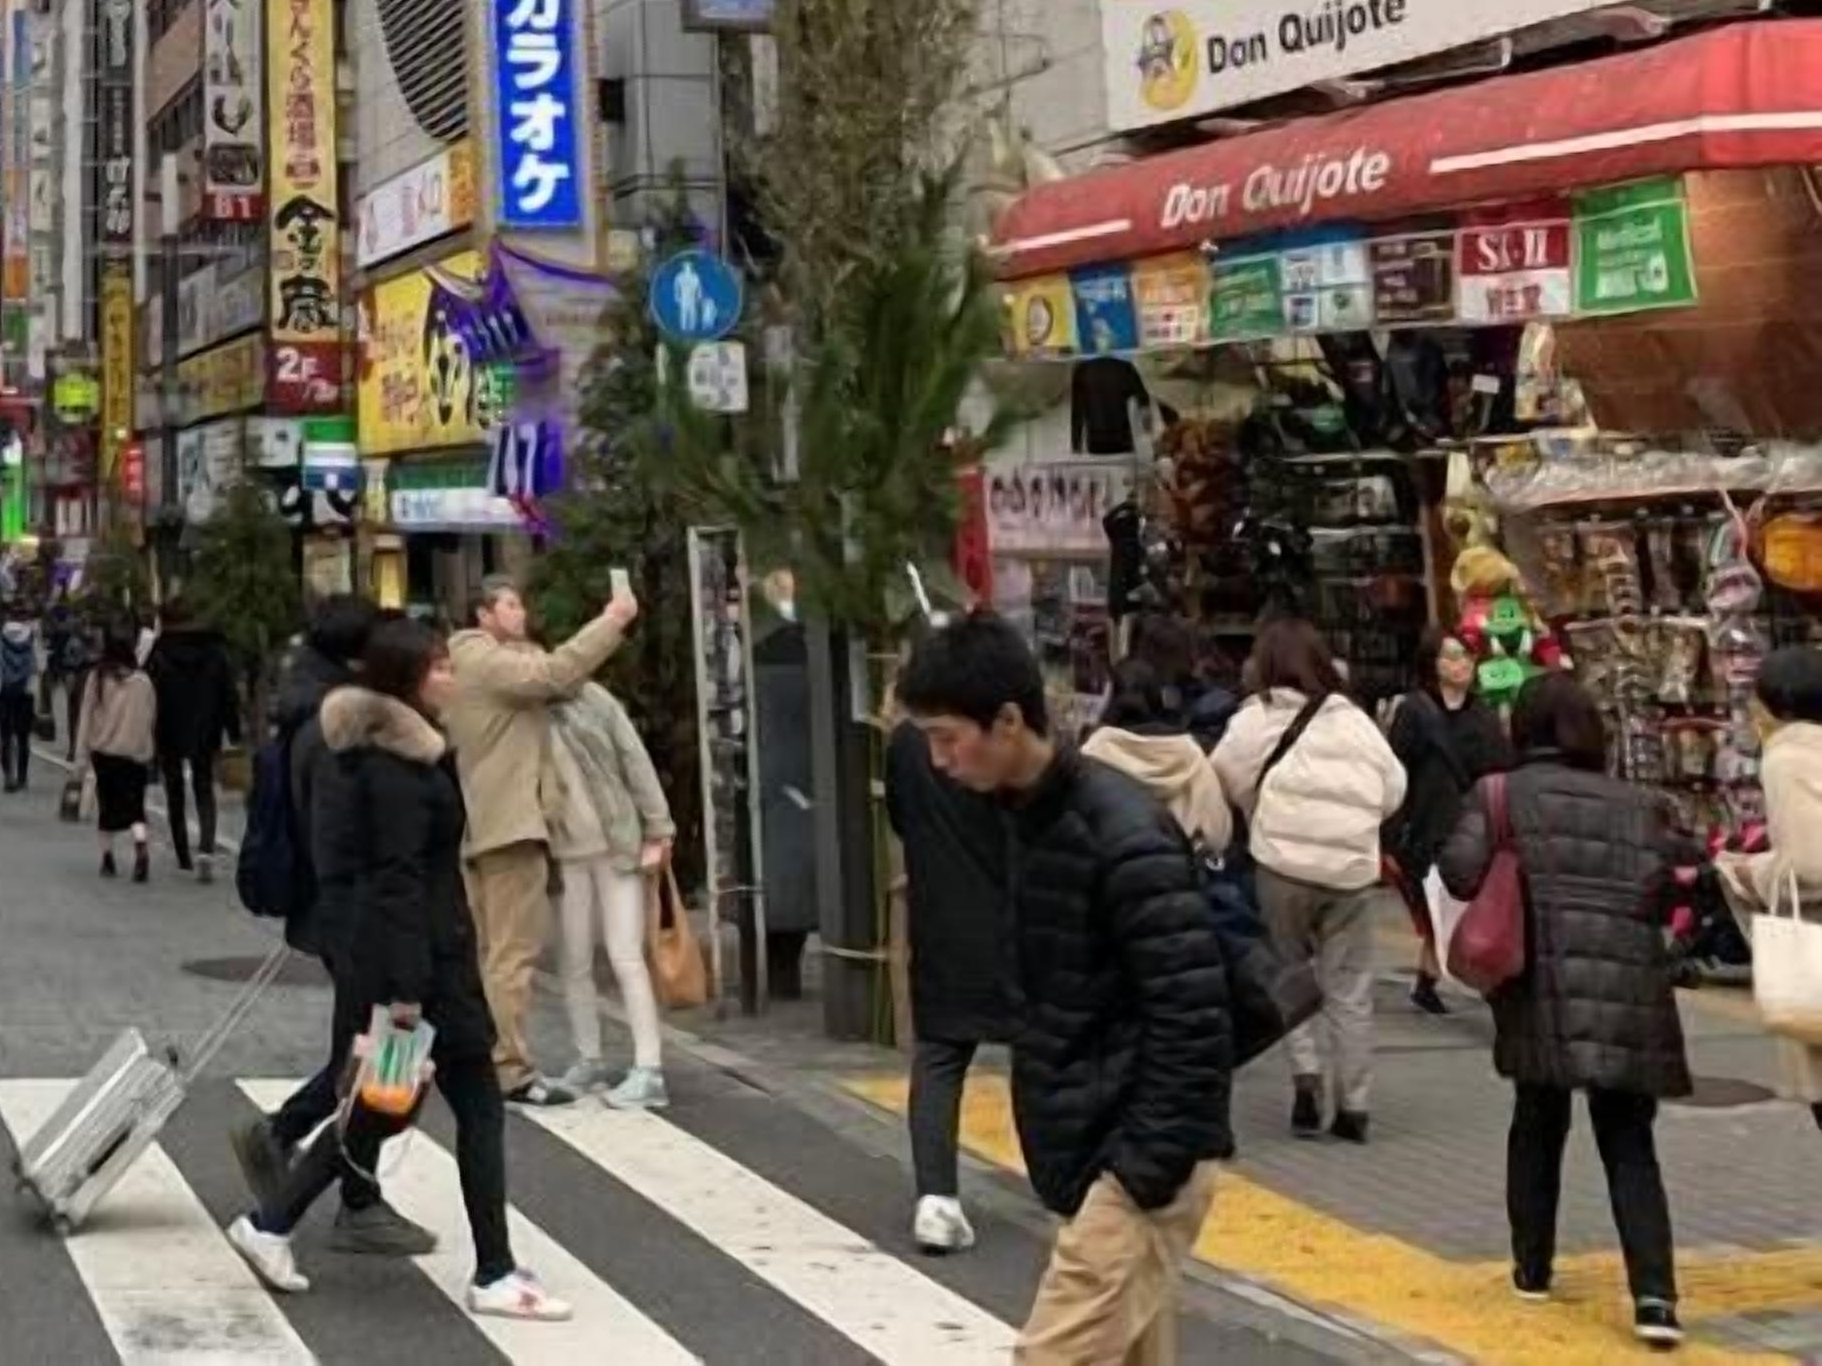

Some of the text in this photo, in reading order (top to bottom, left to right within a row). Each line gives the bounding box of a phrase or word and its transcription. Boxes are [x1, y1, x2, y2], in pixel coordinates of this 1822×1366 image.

[1205, 28, 1267, 79] Don
[1162, 147, 1391, 229] Don Quijote
